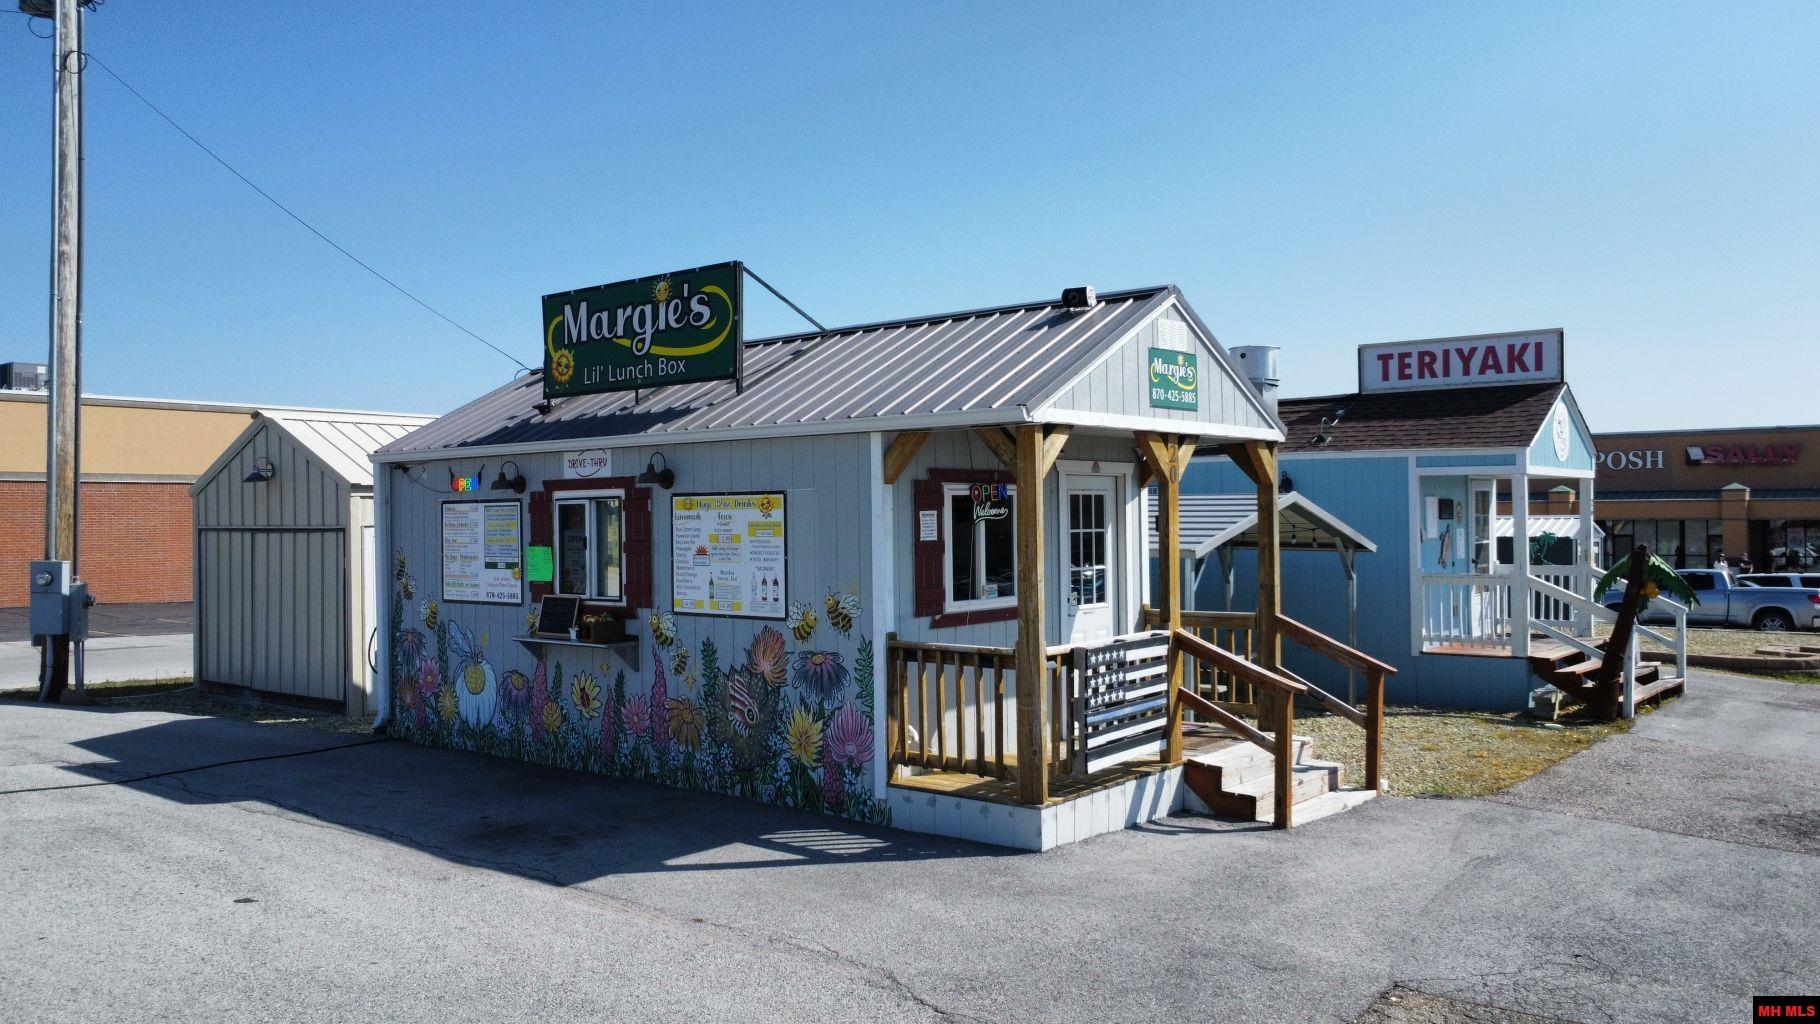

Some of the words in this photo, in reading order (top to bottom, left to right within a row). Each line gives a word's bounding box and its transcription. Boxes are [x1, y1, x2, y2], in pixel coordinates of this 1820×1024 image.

[564, 283, 711, 356] Margie's
[584, 365, 604, 385] Lil'
[608, 359, 653, 382] Lunch
[658, 358, 686, 376] Box
[1154, 357, 1193, 384] Margie's
[1377, 341, 1544, 382] TERIYAKI
[1152, 388, 1196, 404] 870-425-5885
[568, 457, 608, 469] DRIVE-THRU
[1169, 445, 1177, 484] 20
[1594, 450, 1664, 470] POSH
[1706, 444, 1801, 466] SALLY
[453, 475, 479, 492] OPEN
[971, 482, 1008, 503] OPEN
[734, 499, 756, 508] Drinks
[973, 501, 1009, 521] Welcome
